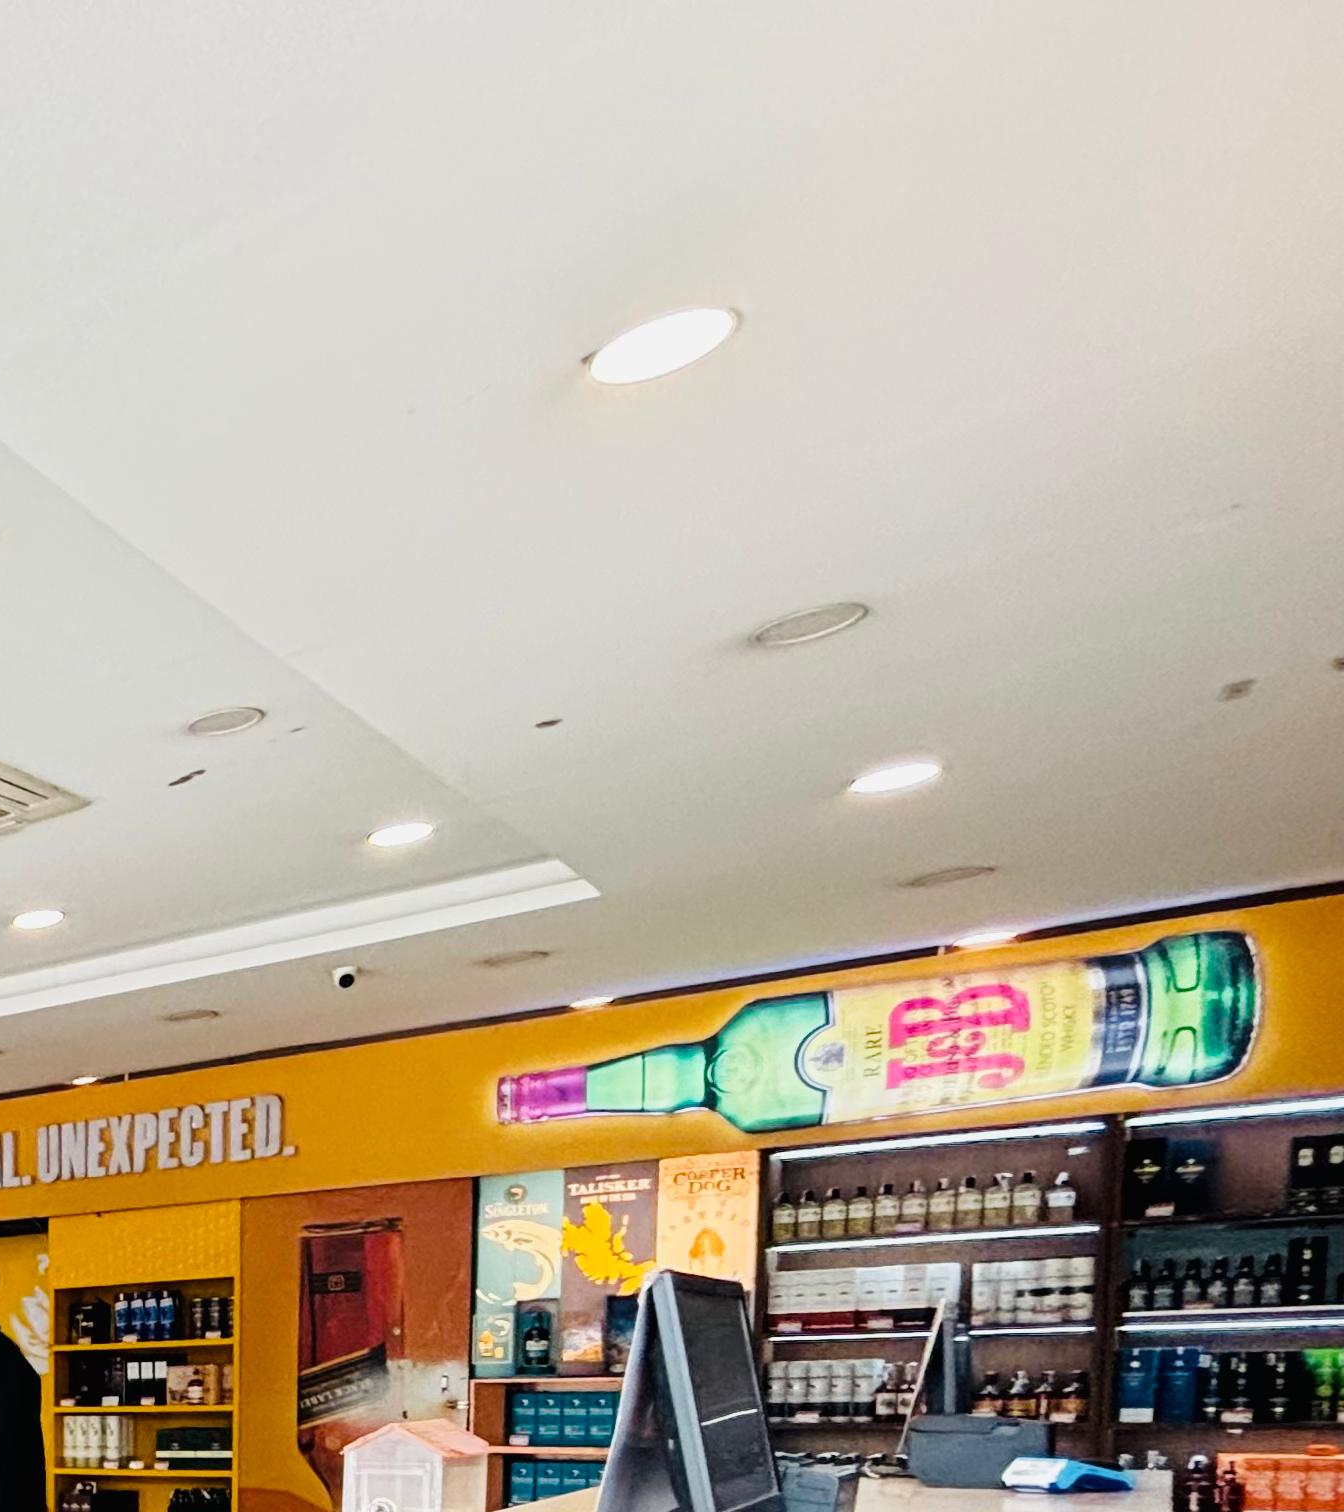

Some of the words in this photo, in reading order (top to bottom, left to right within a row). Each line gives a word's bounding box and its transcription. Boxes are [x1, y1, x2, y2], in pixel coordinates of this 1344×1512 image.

[864, 1024, 882, 1078] RARE
[886, 984, 1031, 1089] J&B
[37, 1094, 297, 1184] UNEXPECTED.
[567, 1178, 652, 1196] TALISKER
[673, 1167, 745, 1186] COPPER
[688, 1180, 731, 1194] DOG
